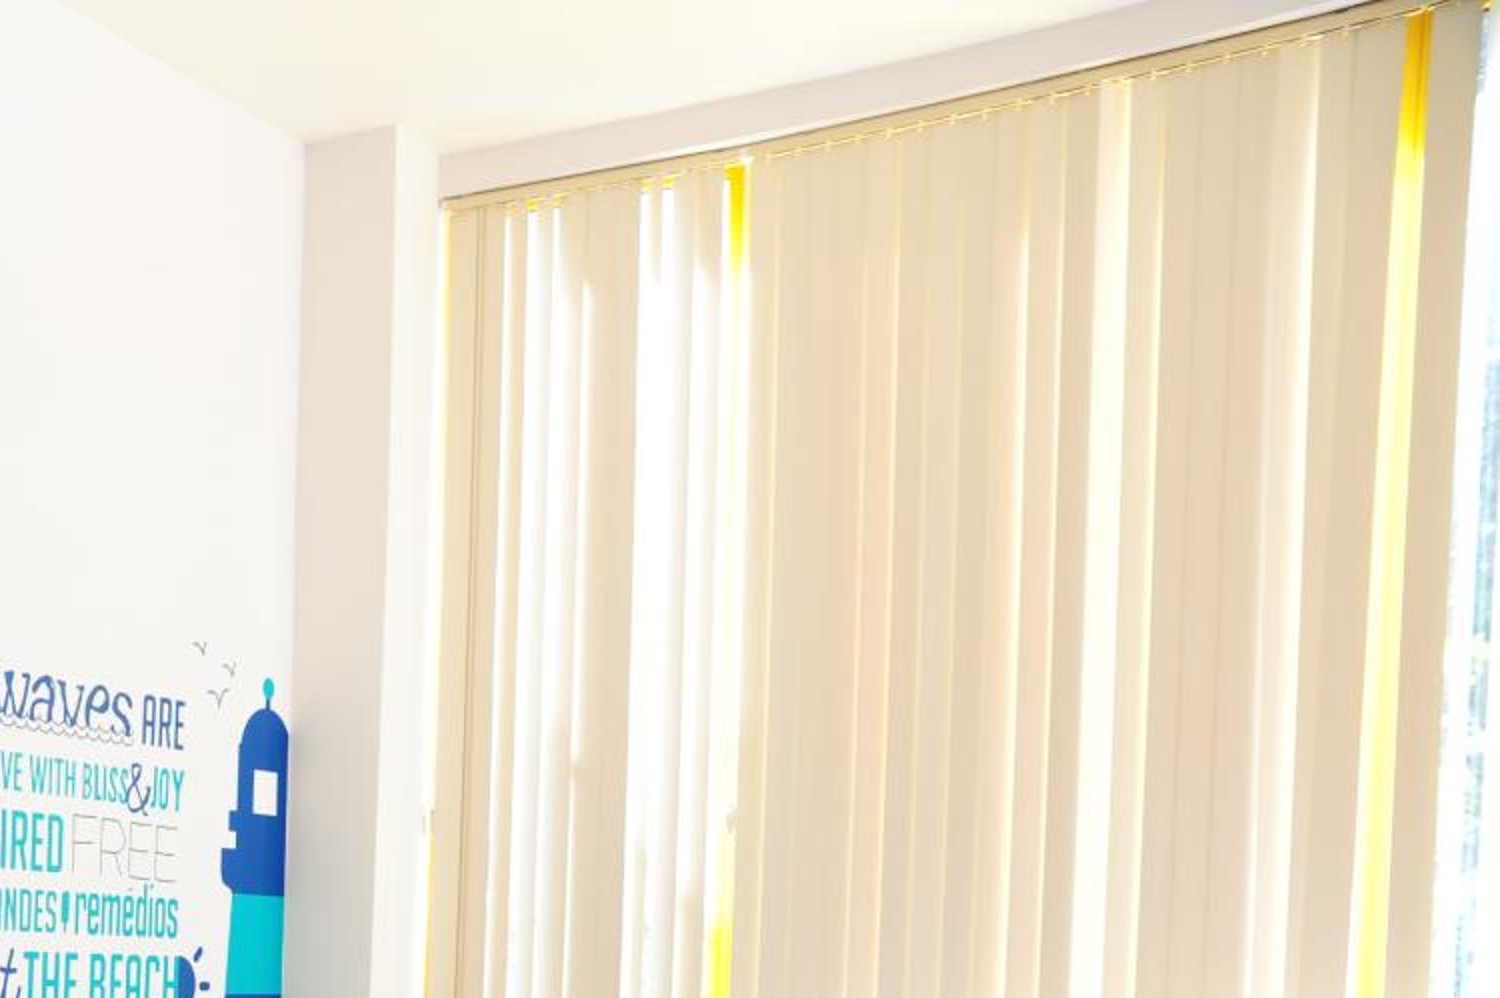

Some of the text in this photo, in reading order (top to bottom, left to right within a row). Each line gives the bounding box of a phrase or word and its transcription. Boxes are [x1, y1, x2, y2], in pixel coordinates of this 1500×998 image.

[141, 693, 186, 751] ARE
[29, 754, 77, 800] WITH
[81, 763, 131, 805] BLISS
[151, 766, 186, 814] JOY
[71, 812, 179, 884] FREE
